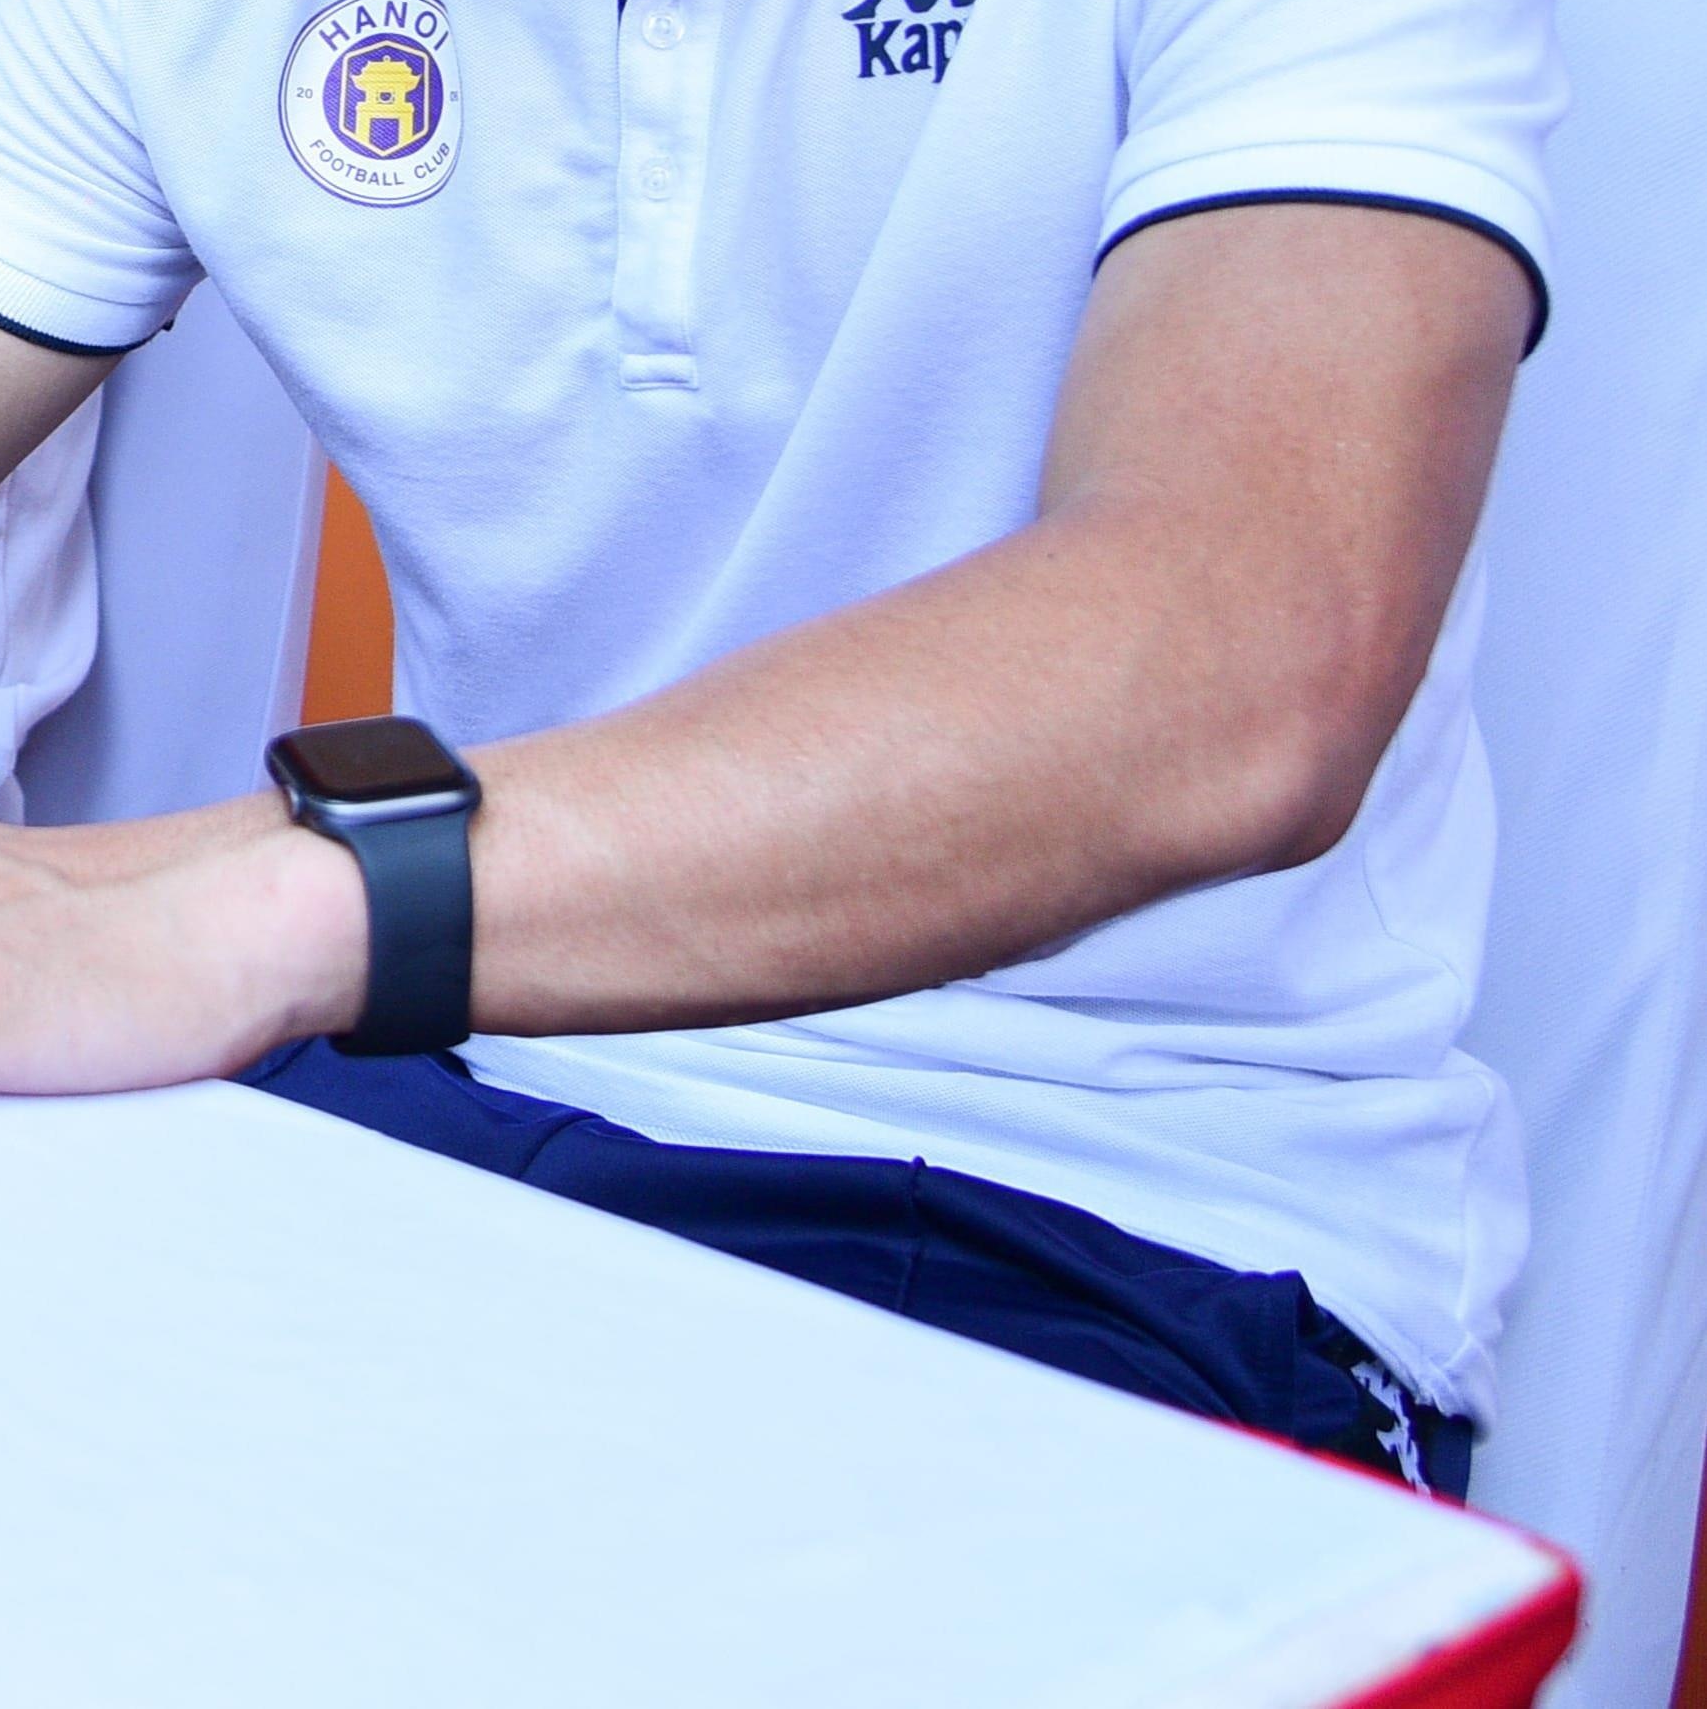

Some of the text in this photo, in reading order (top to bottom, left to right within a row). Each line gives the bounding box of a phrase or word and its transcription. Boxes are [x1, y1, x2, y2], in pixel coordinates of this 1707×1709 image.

[318, 0, 449, 52] HANOI
[853, 18, 969, 84] Kap
[309, 138, 451, 187] FOOTBALL CLUB
